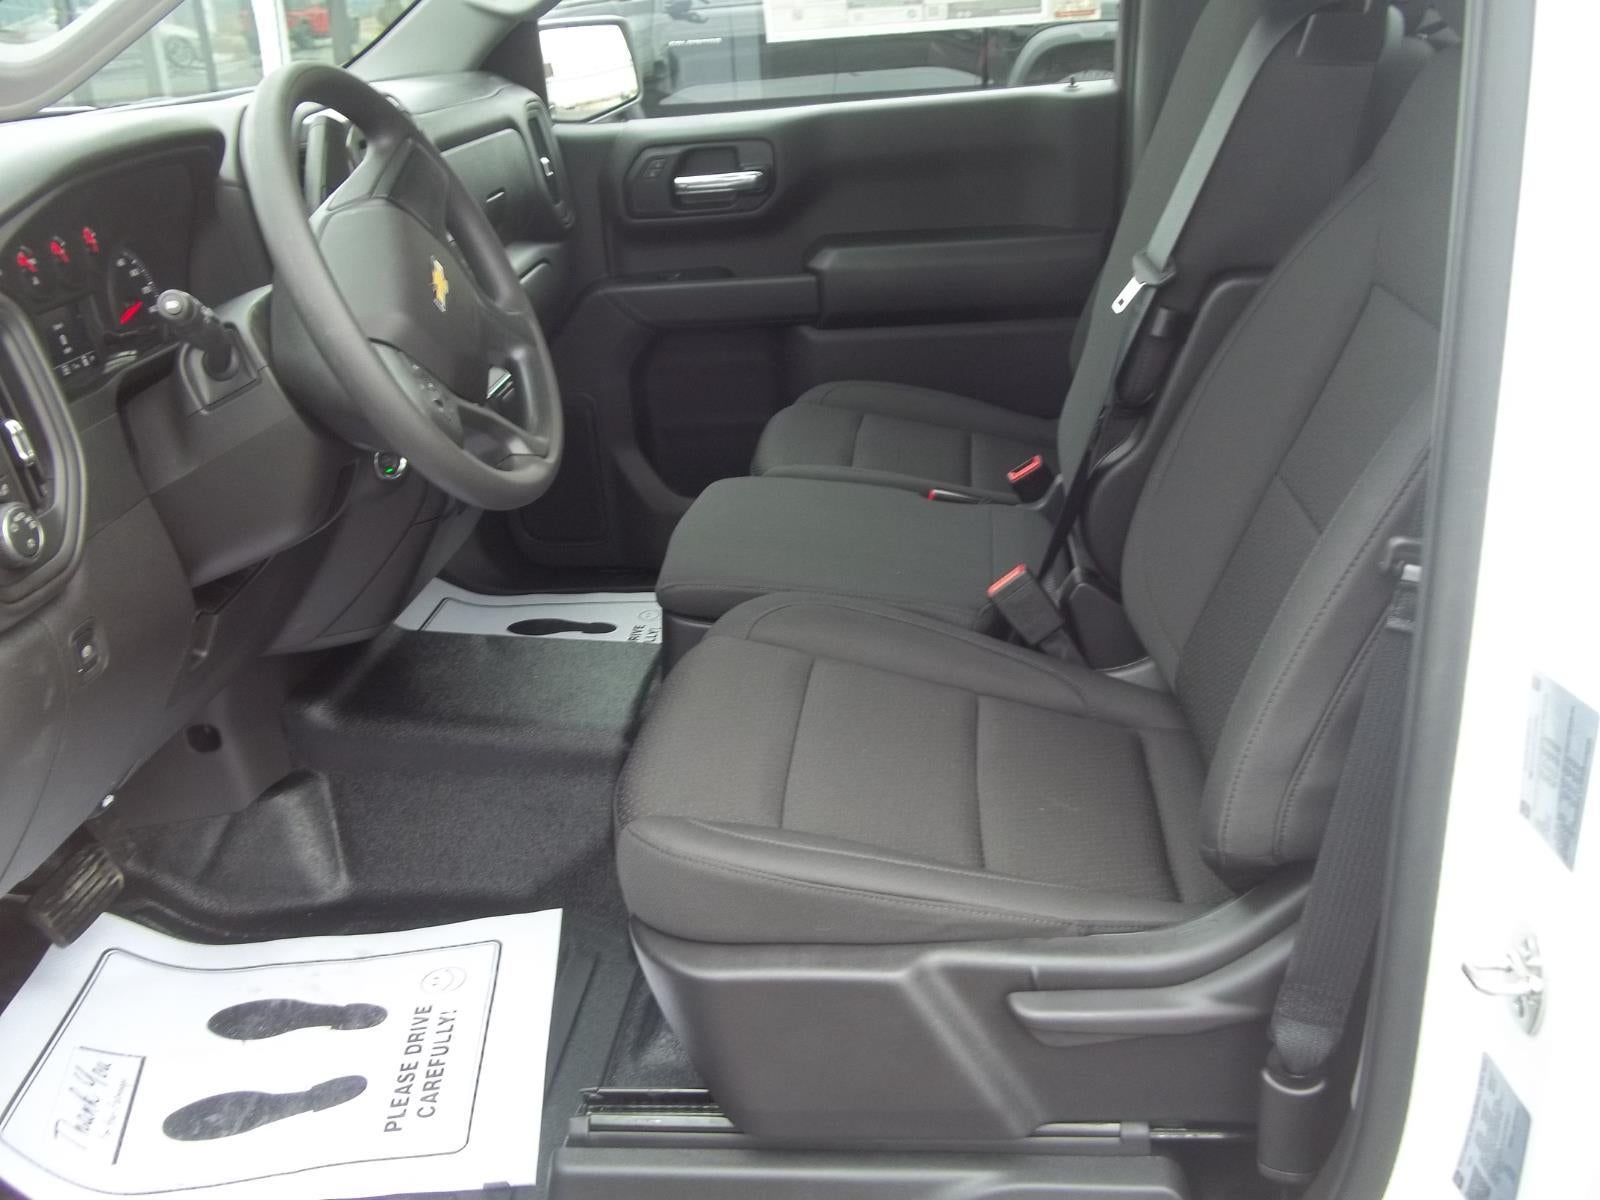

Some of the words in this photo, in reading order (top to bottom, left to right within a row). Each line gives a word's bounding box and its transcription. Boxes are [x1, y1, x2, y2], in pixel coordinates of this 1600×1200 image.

[627, 624, 647, 641] RIVE
[383, 1060, 420, 1133] PLEASE
[403, 1004, 433, 1056] DRIVE
[416, 1009, 458, 1119] CAREFULLY!
